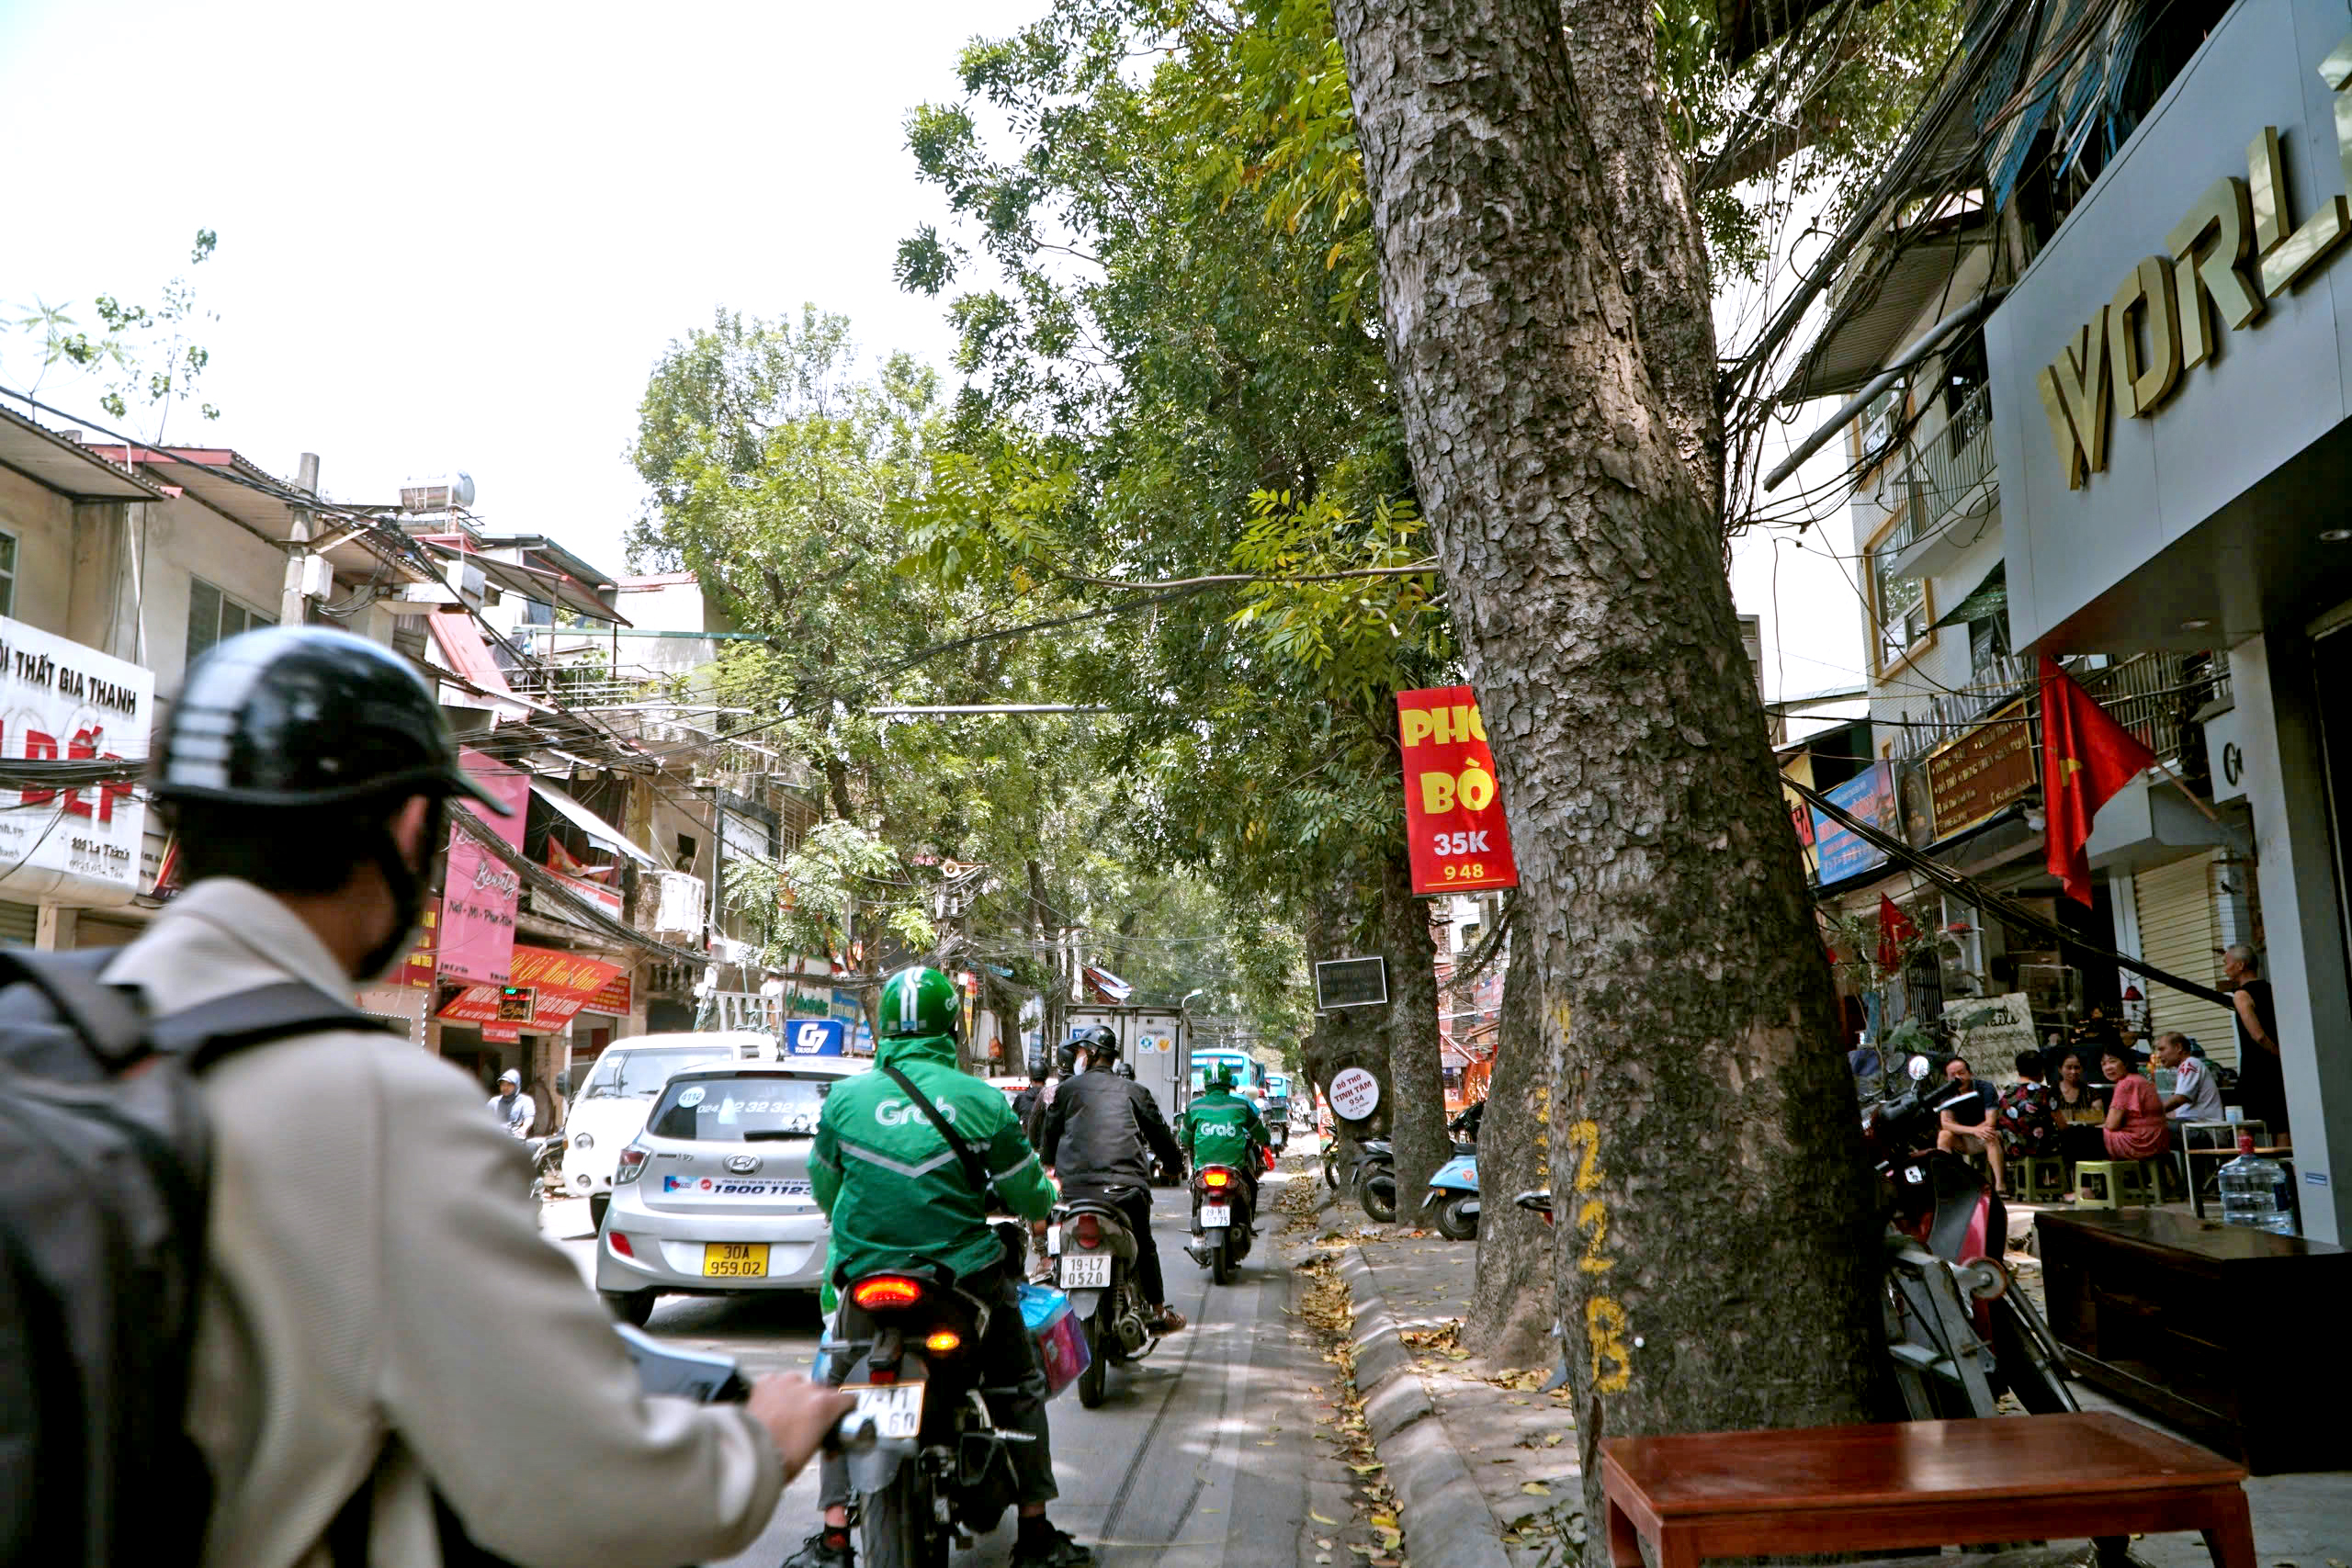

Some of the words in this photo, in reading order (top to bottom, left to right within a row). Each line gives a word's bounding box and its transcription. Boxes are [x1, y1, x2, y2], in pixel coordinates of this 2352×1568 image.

[16, 650, 55, 686] THẤT
[59, 667, 84, 697] GIA
[88, 676, 136, 715] THANH
[1420, 757, 1494, 814] BÒ
[1434, 830, 1490, 856] 35K
[1444, 864, 1484, 880] 948
[473, 860, 518, 900] Beauty
[797, 1022, 830, 1054] G7
[681, 1093, 701, 1102] 4112
[1349, 1094, 1364, 1107] 954
[1200, 1121, 1237, 1138] Grab
[714, 1185, 765, 1194] 1900
[723, 1246, 750, 1259] 30A
[710, 1261, 761, 1275] 959.02
[1071, 1258, 1102, 1271] 19-L7
[1069, 1272, 1102, 1285] 0520
